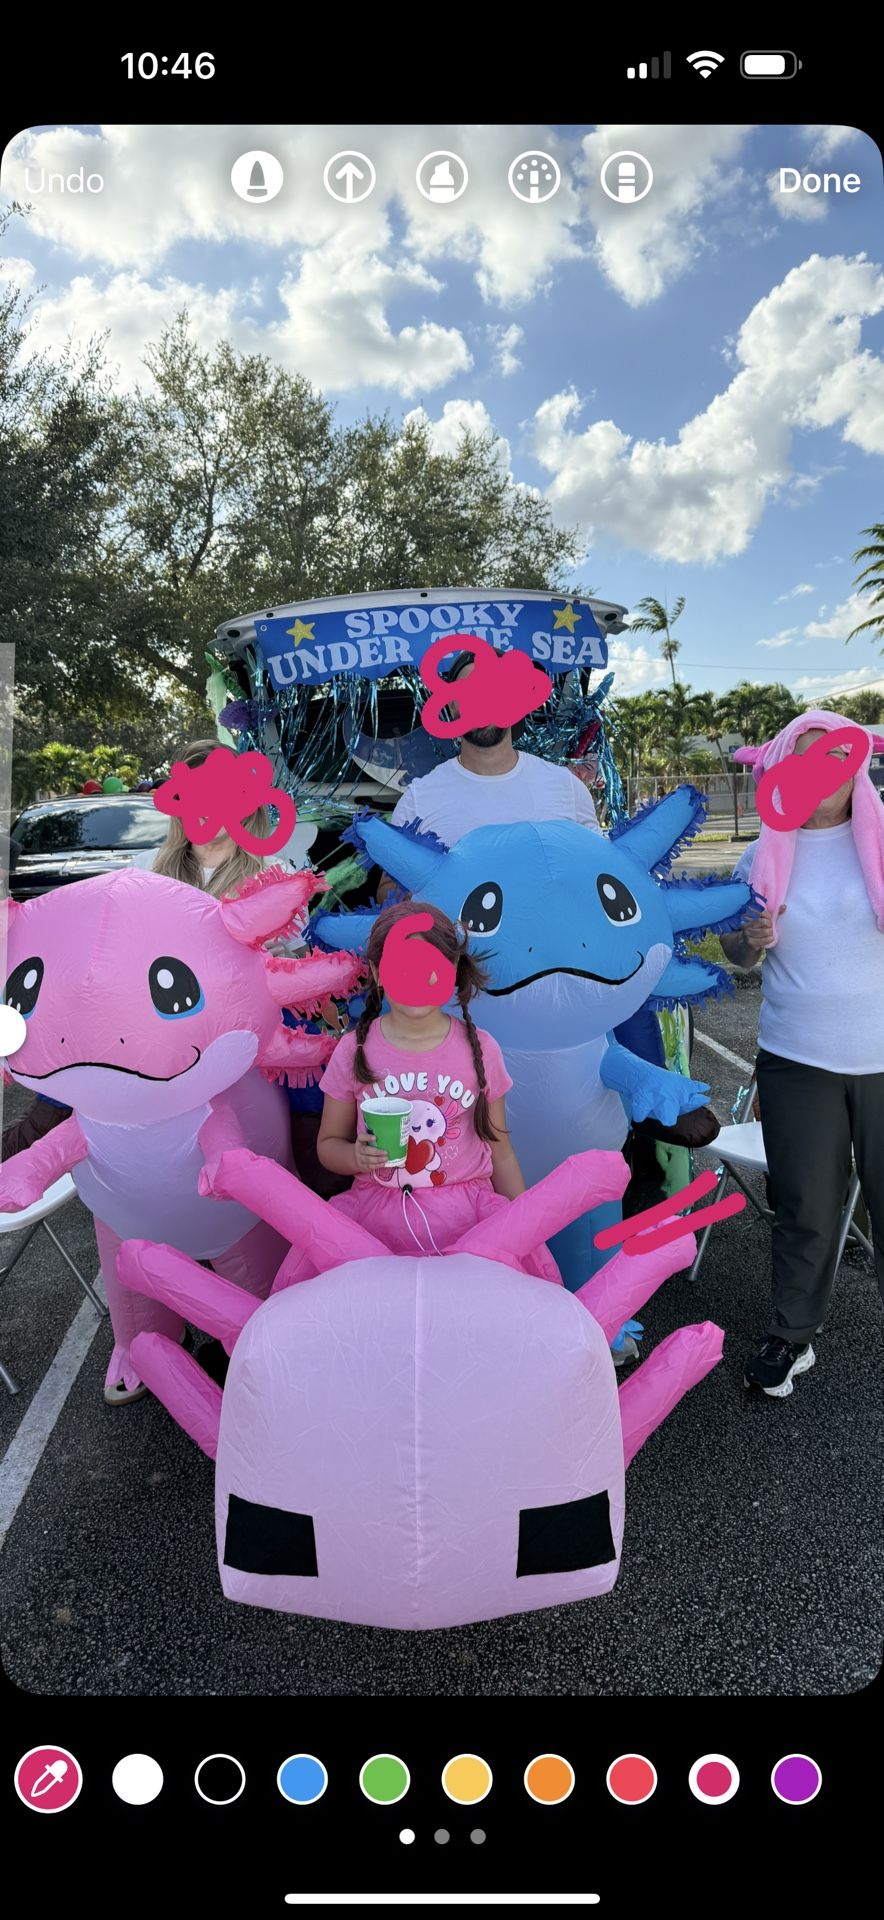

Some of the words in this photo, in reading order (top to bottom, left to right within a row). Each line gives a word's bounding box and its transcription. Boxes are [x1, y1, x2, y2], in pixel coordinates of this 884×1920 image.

[344, 603, 524, 639] SPOOKY
[266, 636, 414, 685] UNDER
[531, 630, 605, 665] SEA
[372, 1071, 428, 1099] LOVE
[437, 1074, 475, 1109] YOU
